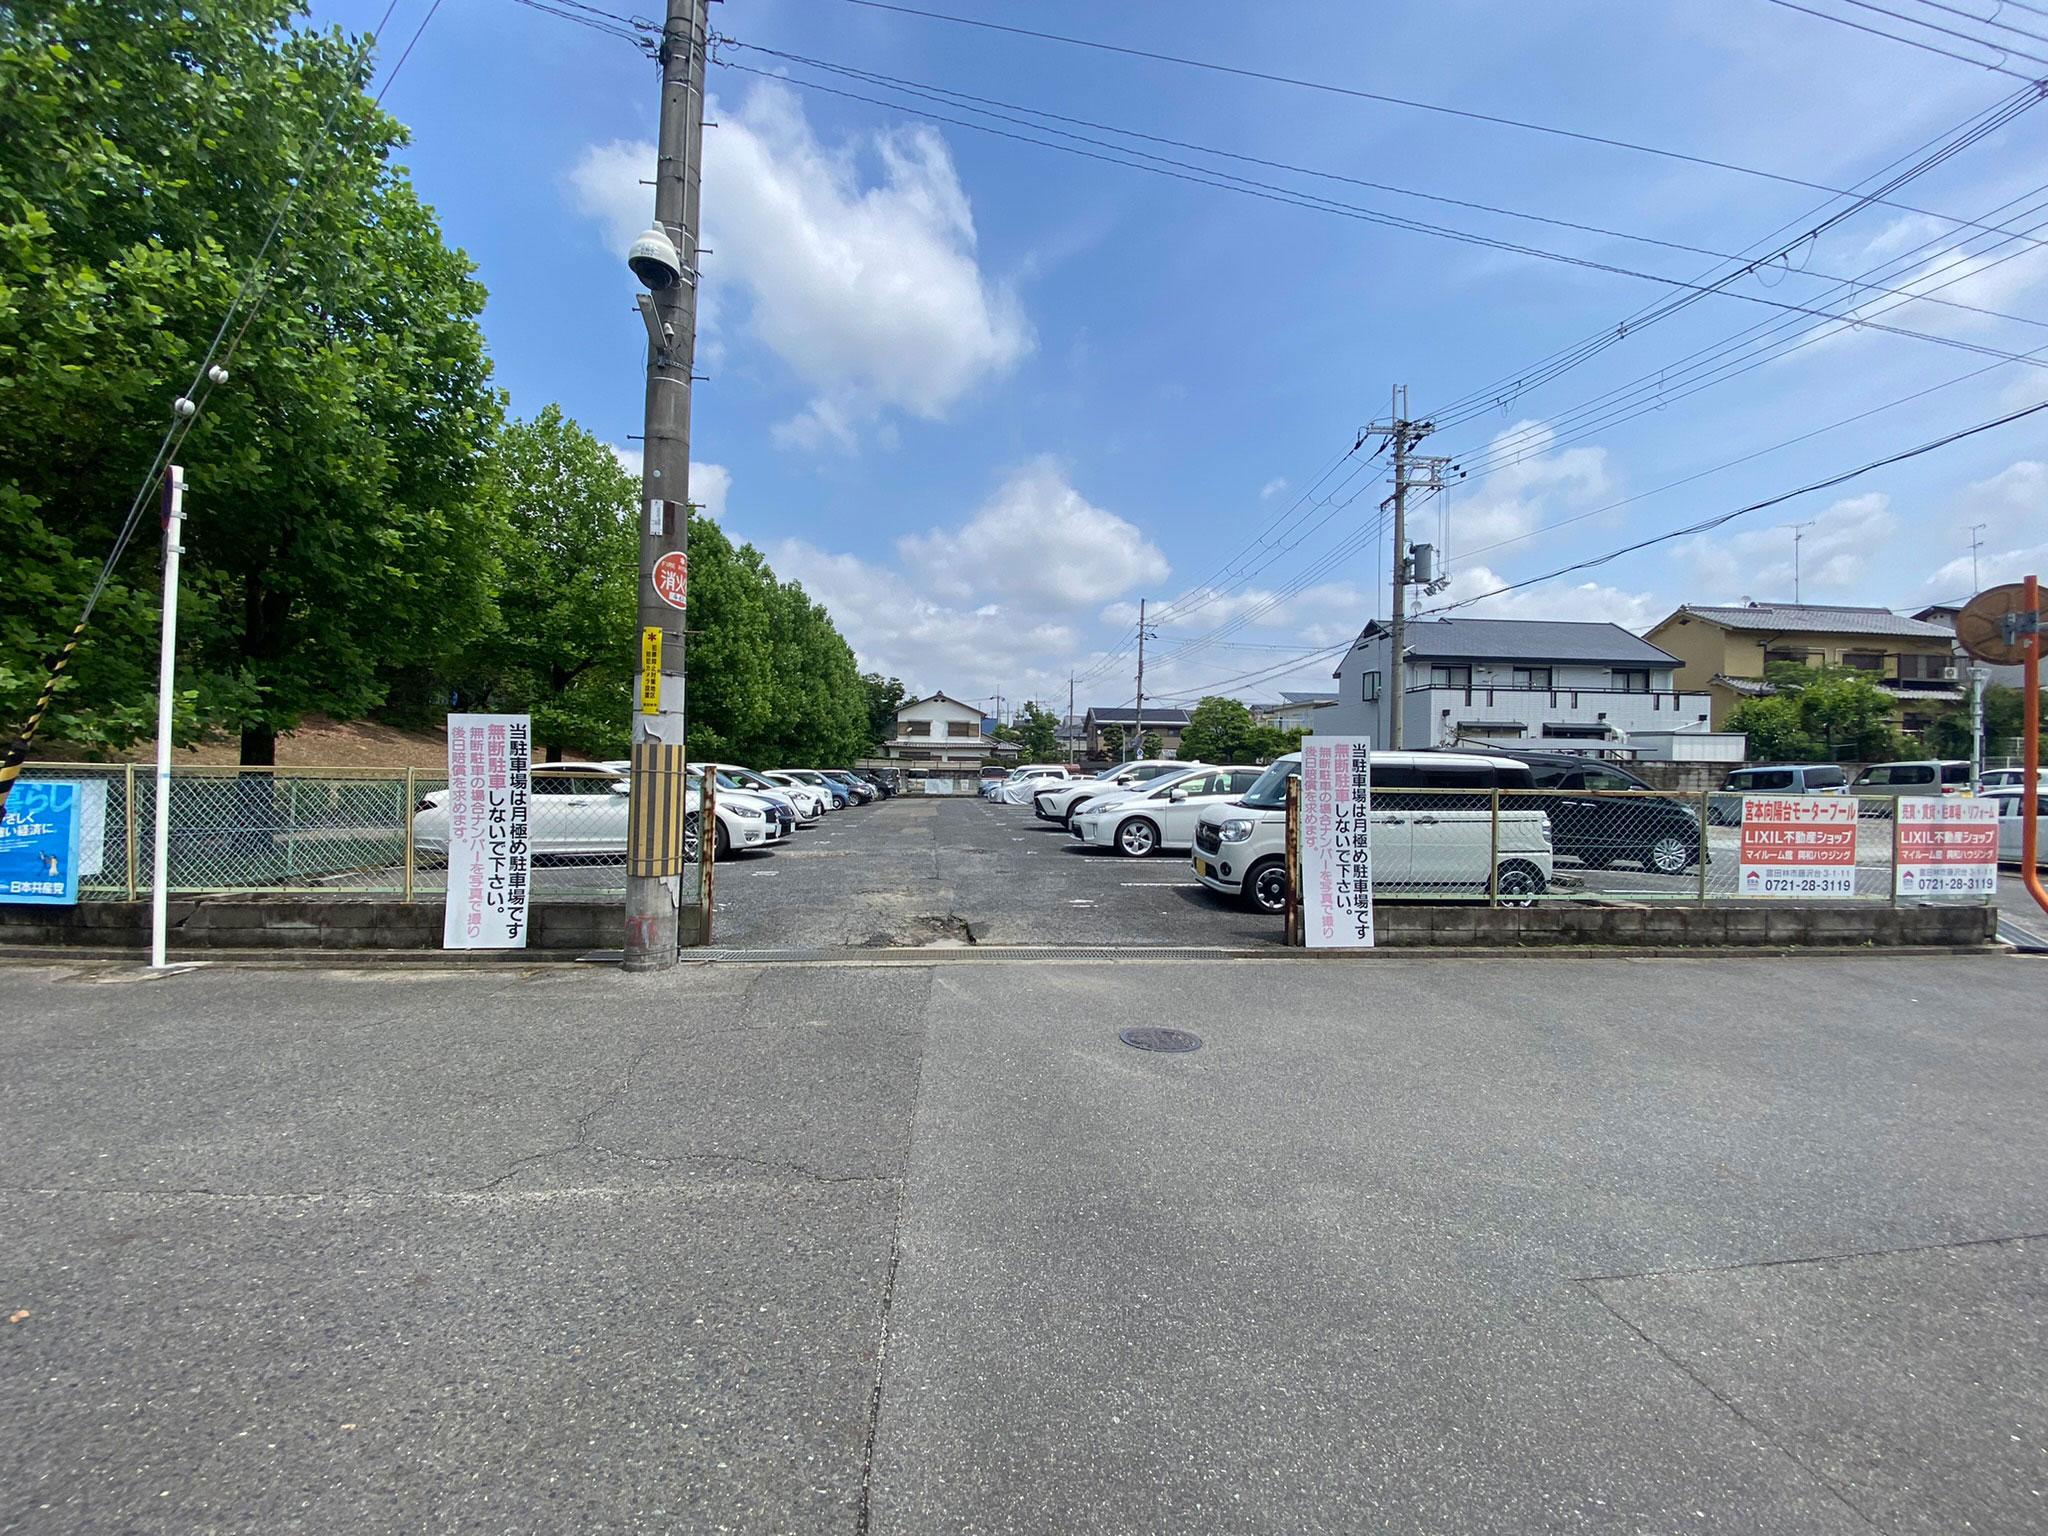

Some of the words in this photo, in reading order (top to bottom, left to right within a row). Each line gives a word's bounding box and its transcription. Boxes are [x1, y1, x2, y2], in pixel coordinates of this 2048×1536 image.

[451, 726, 468, 844] 後日賠償を求めます。
[467, 727, 486, 938] 無断駐車の場合ナンバーを写真で撮り
[487, 723, 506, 914] 無断駐車しないで下さい。
[506, 723, 528, 939] 当駐車場は月極め駐車場です
[1304, 746, 1319, 851] 後日賠償を求めます。
[1319, 747, 1334, 939] 無断駐車の場合ナンバーを写真で撮り
[1335, 744, 1353, 916] 無断駐車しないで下さい。
[1352, 743, 1370, 939] 当駐車場は月極め駐車場です
[1745, 830, 1853, 845] LIXIL不動産ショップ
[1900, 831, 1995, 844] LIXIL不動産ショップ
[1765, 880, 1851, 891] 0721-28-3119
[1919, 878, 1993, 890] 0721-28-3119
